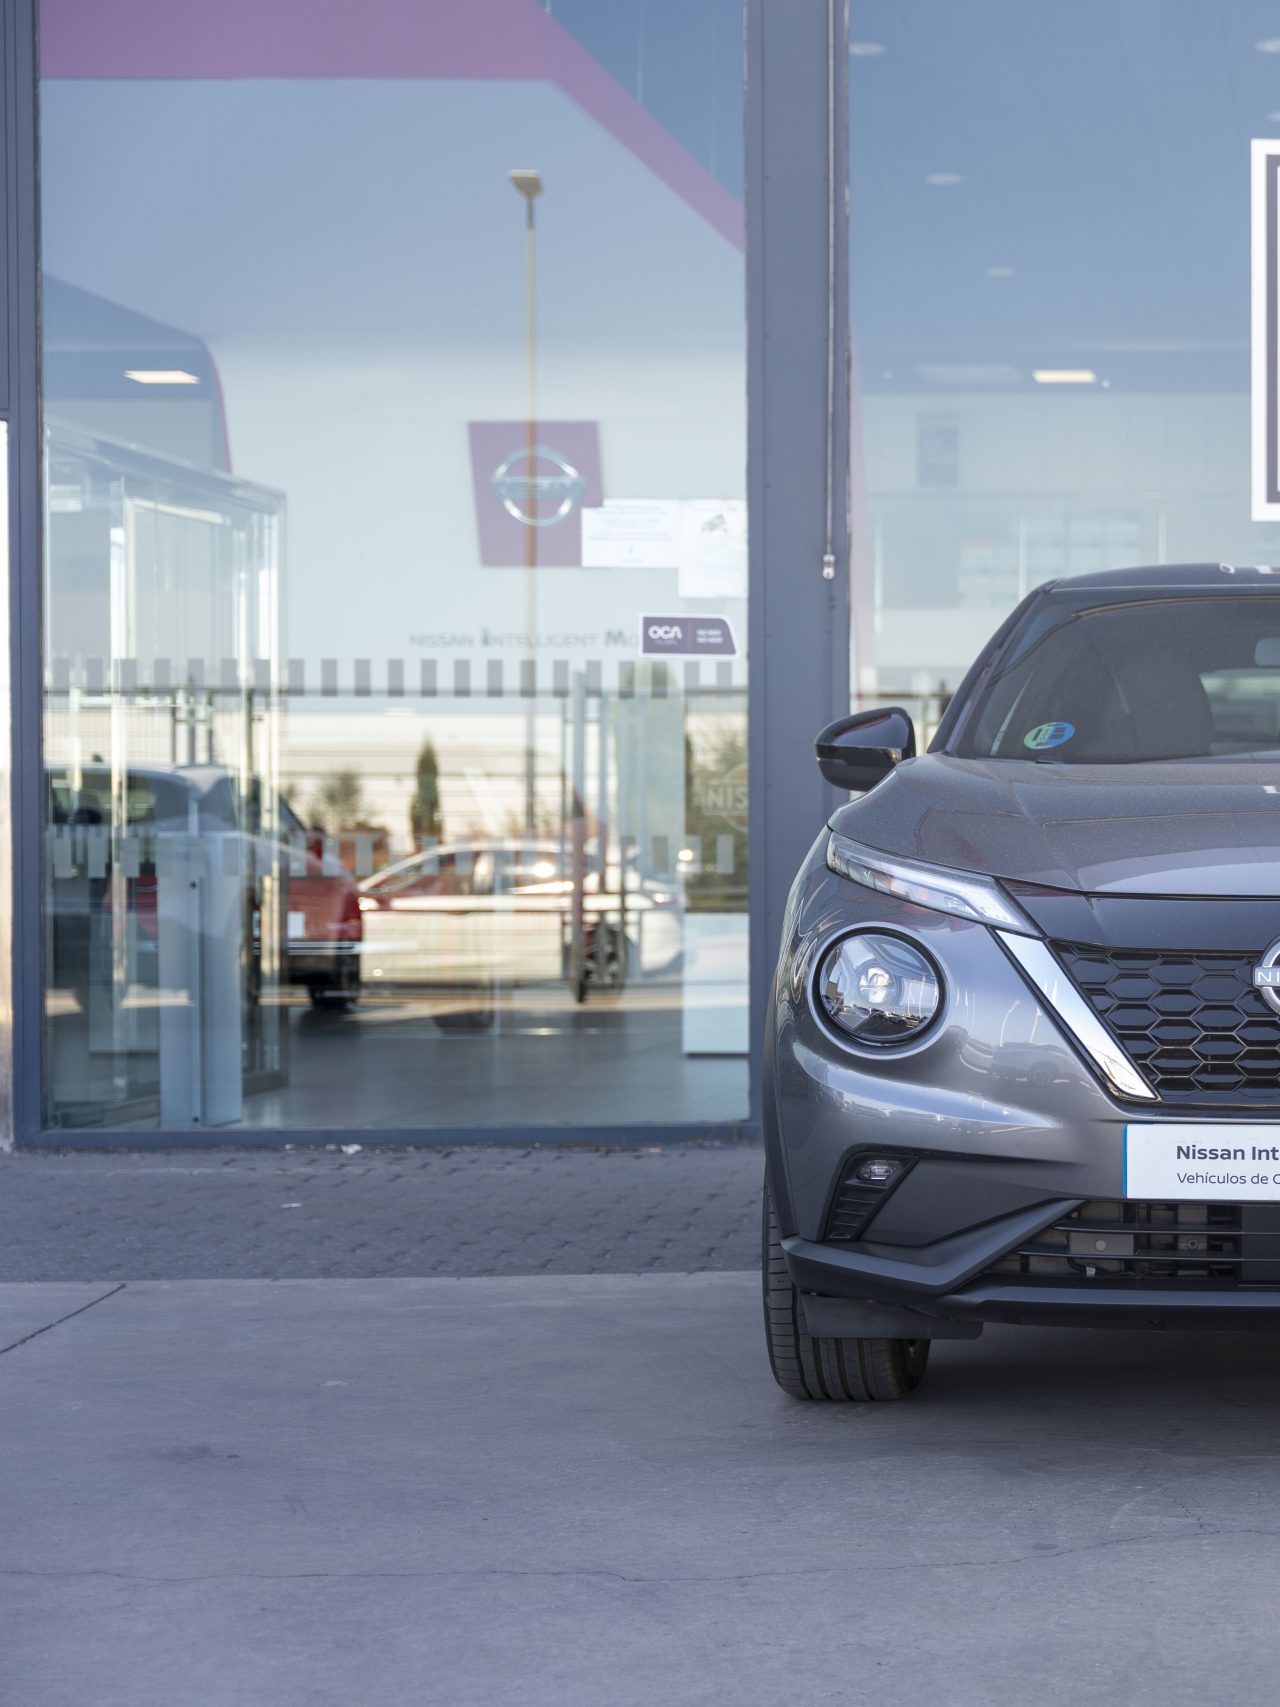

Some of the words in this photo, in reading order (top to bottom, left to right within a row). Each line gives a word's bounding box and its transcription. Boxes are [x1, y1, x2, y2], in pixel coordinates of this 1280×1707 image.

[1176, 1145, 1246, 1161] Nissan
[1176, 1172, 1247, 1185] Vehículos
[1250, 1173, 1269, 1185] de
